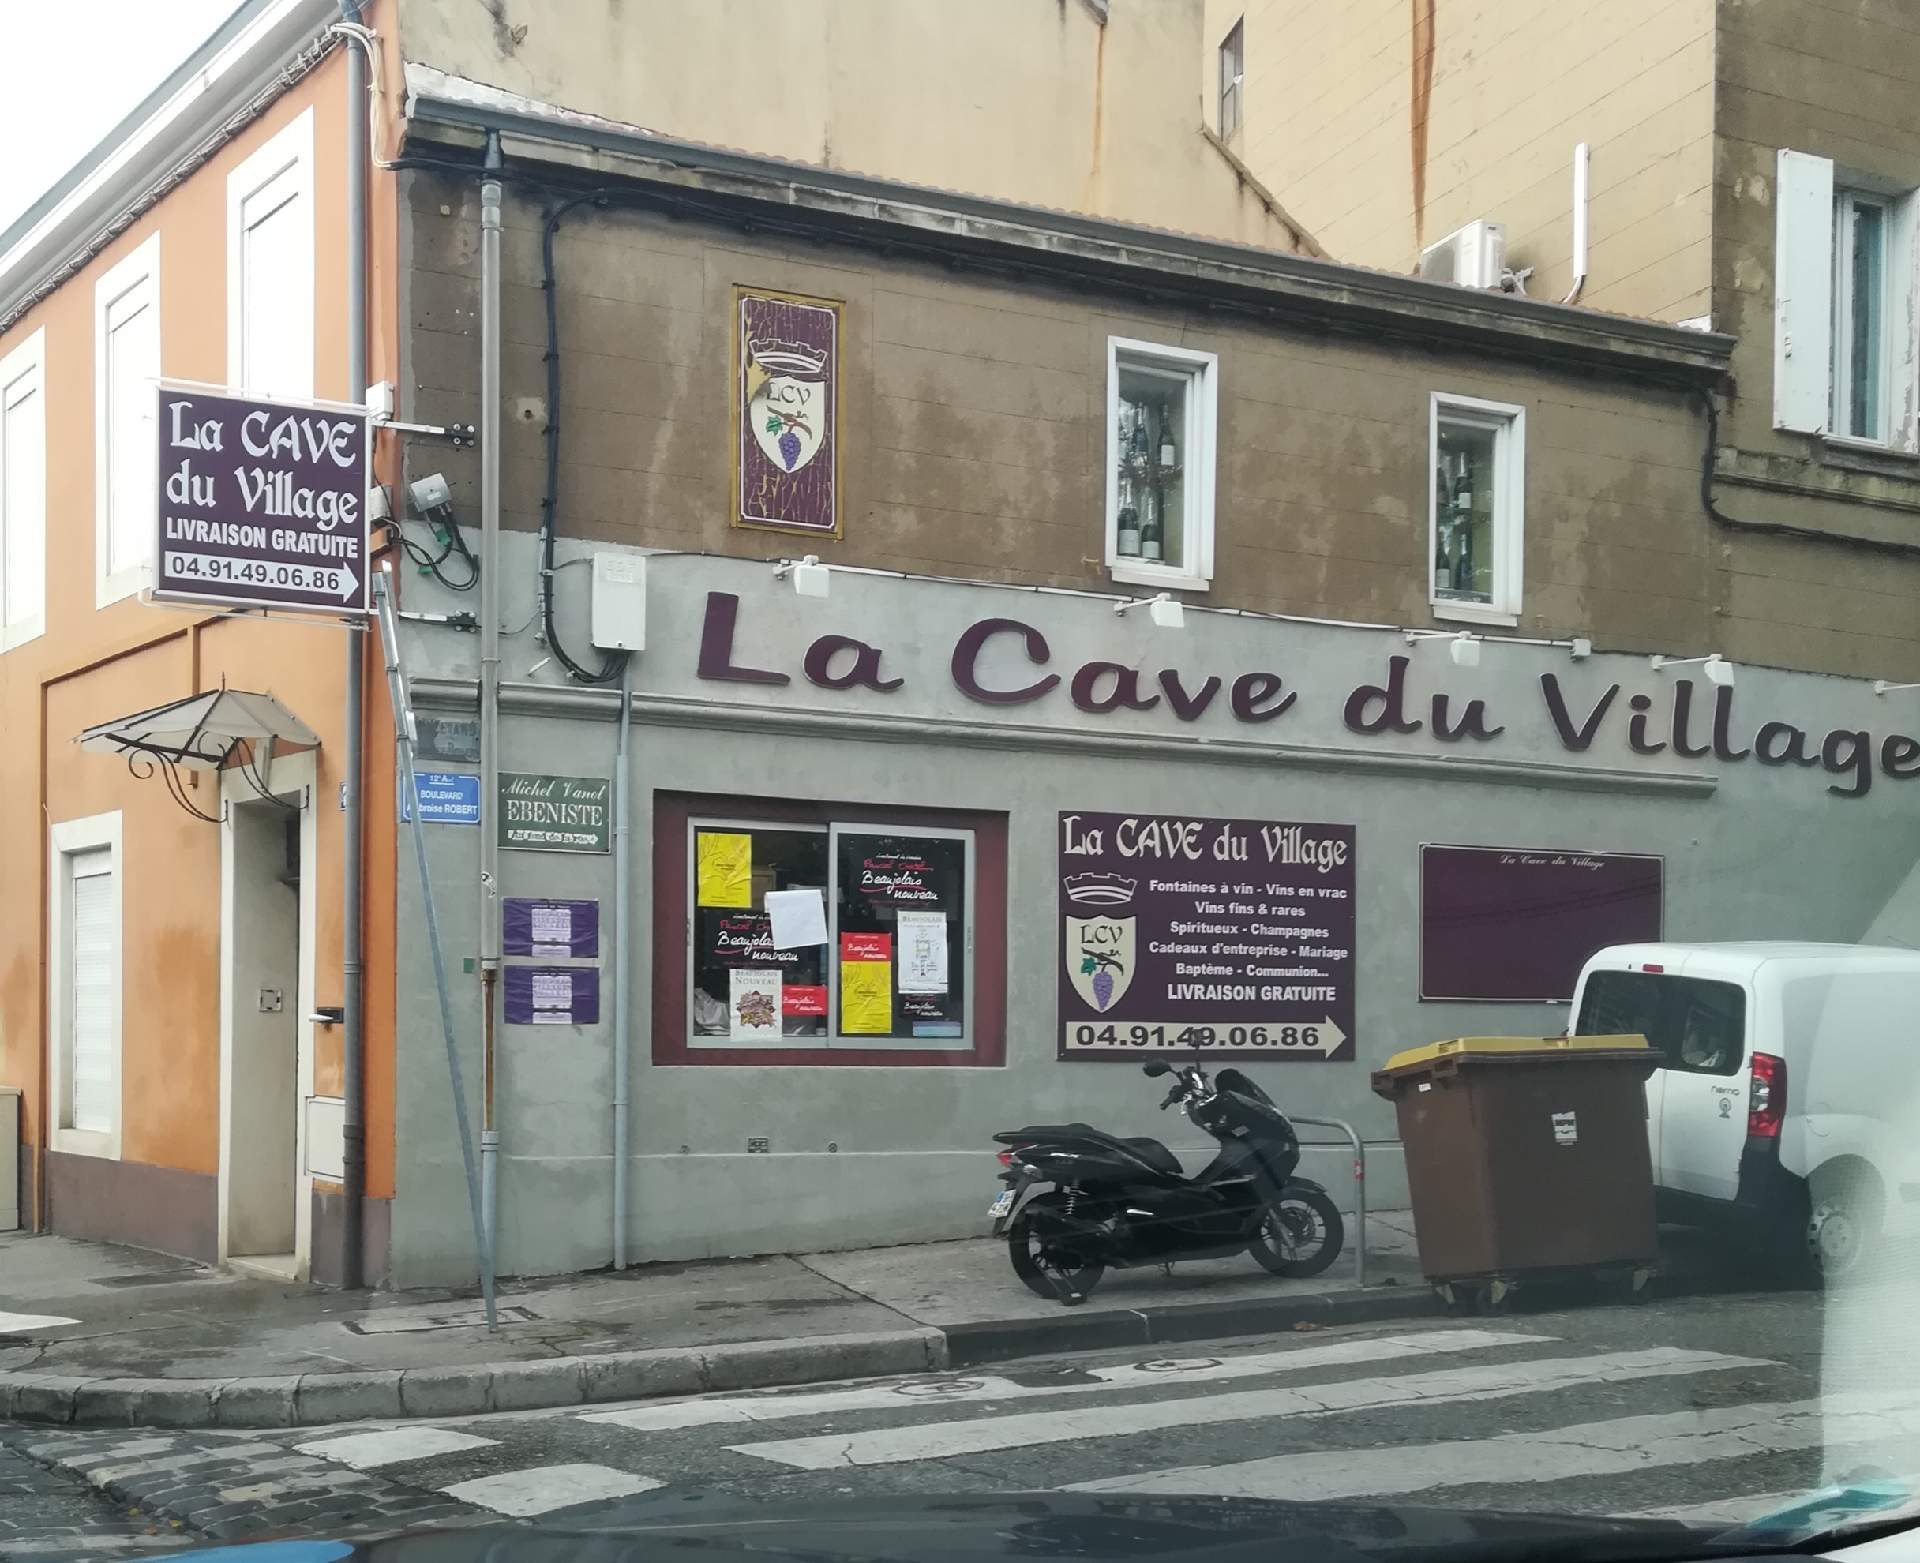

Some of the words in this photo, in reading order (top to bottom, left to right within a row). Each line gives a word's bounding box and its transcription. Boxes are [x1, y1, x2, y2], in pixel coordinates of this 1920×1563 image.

[168, 401, 224, 452] La
[241, 410, 356, 468] CAVE
[166, 459, 217, 508] du
[234, 466, 359, 531] Village
[166, 517, 266, 549] LIVRAISON
[271, 529, 359, 559] GRATUITE
[172, 556, 339, 590] 04.91.49.06.86
[697, 591, 904, 692] La
[951, 617, 1297, 723] Cave
[1343, 655, 1505, 742] du
[1539, 672, 1920, 797] Village
[420, 789, 464, 800] BOULEVARD
[501, 778, 556, 797] Michel
[443, 803, 478, 815] ROBERT
[506, 799, 603, 826] EBENISTE
[1062, 815, 1104, 856] La
[1116, 818, 1204, 860] CAVE
[1212, 823, 1248, 861] du
[1260, 825, 1348, 874] Village
[1500, 854, 1517, 864] La
[1551, 855, 1567, 865] du
[1570, 857, 1606, 871] Village
[861, 869, 923, 894] Beaujolais
[1149, 879, 1217, 893] Fontaines
[1220, 882, 1229, 894] à
[1233, 882, 1254, 895] vin
[1265, 883, 1295, 896] Vins
[1298, 887, 1315, 897] en
[1317, 888, 1347, 898] vrac
[893, 889, 939, 900] nouveau
[1194, 901, 1225, 914] Vins
[1228, 901, 1254, 914] fins
[1257, 903, 1268, 915] &
[1271, 905, 1306, 917] rares
[1079, 924, 1123, 944] LCV
[1170, 921, 1239, 935] Spiritueux
[1250, 923, 1330, 940] Champagnes
[752, 950, 799, 961] nouveau
[1149, 941, 1208, 954] Cadeaux
[1211, 942, 1288, 958] d'entreprise
[1298, 945, 1349, 961] Mariage
[1167, 983, 1256, 1000] LIVRAISON
[1260, 985, 1337, 1001] GRATUITE
[1075, 1025, 1320, 1047] 04.91.49.06.86
